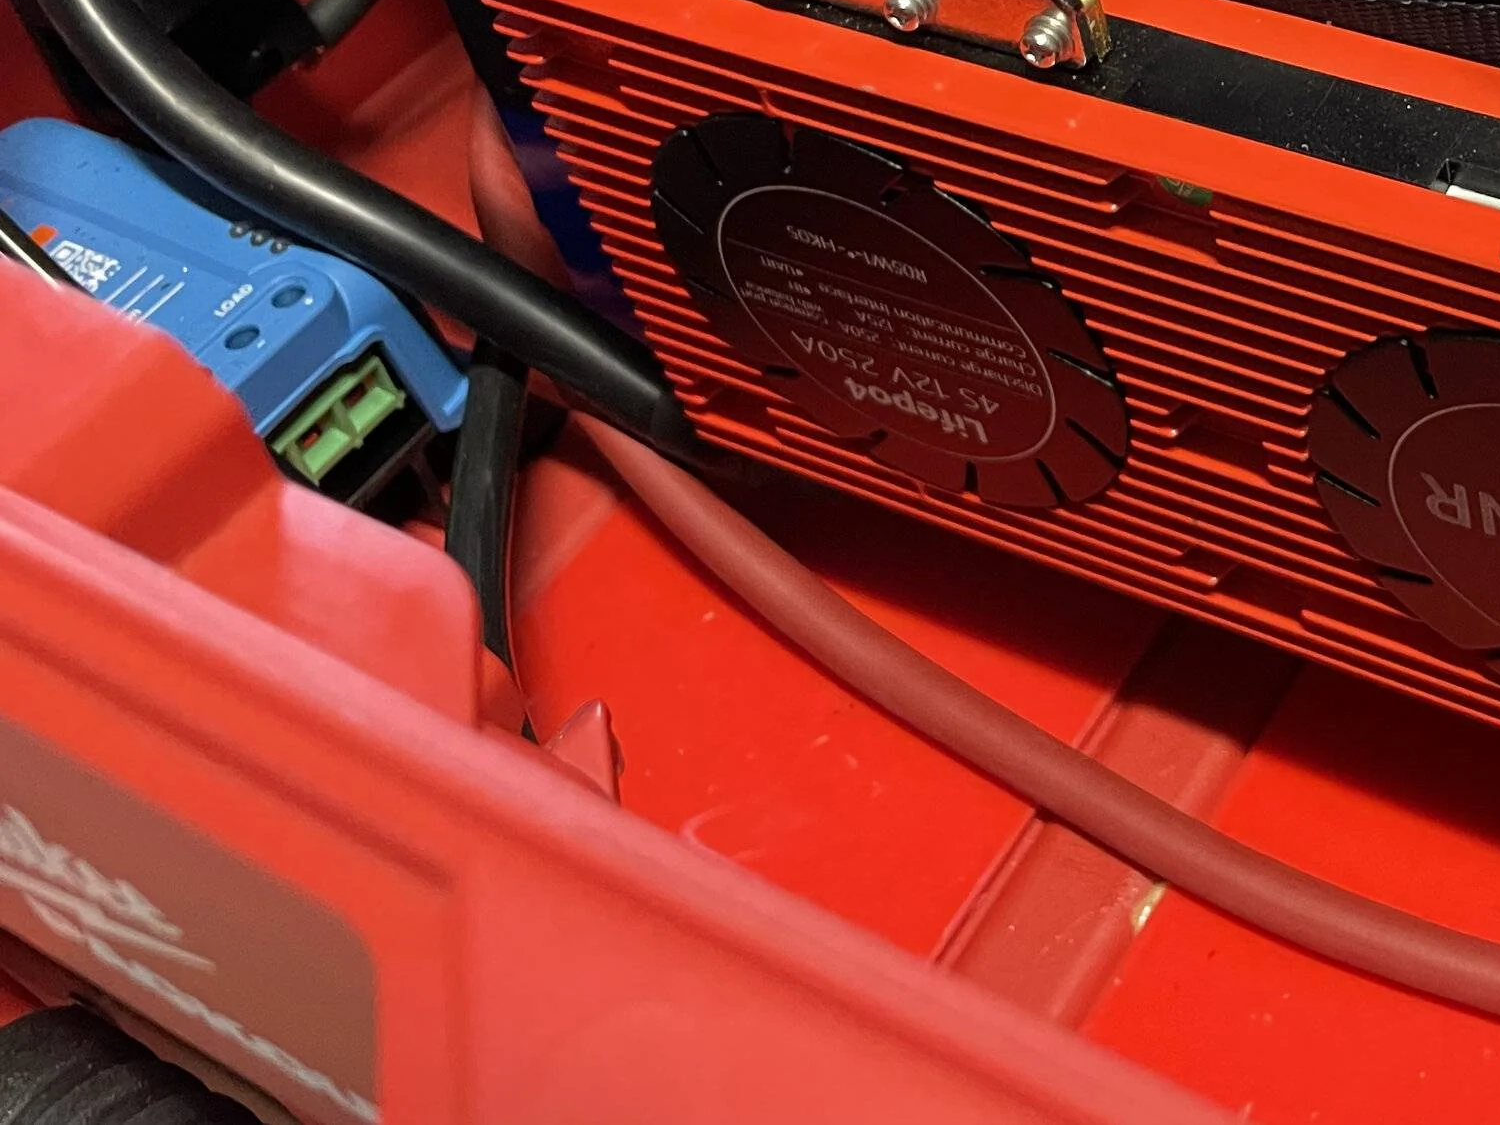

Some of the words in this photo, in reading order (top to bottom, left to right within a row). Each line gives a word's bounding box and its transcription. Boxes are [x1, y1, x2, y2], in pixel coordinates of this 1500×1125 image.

[214, 283, 253, 317] LOAD
[791, 330, 880, 376] 250A
[974, 347, 1037, 377] Charge
[892, 366, 949, 399] 12V
[844, 377, 988, 445] Lifepo4
[958, 386, 999, 415] 4S
